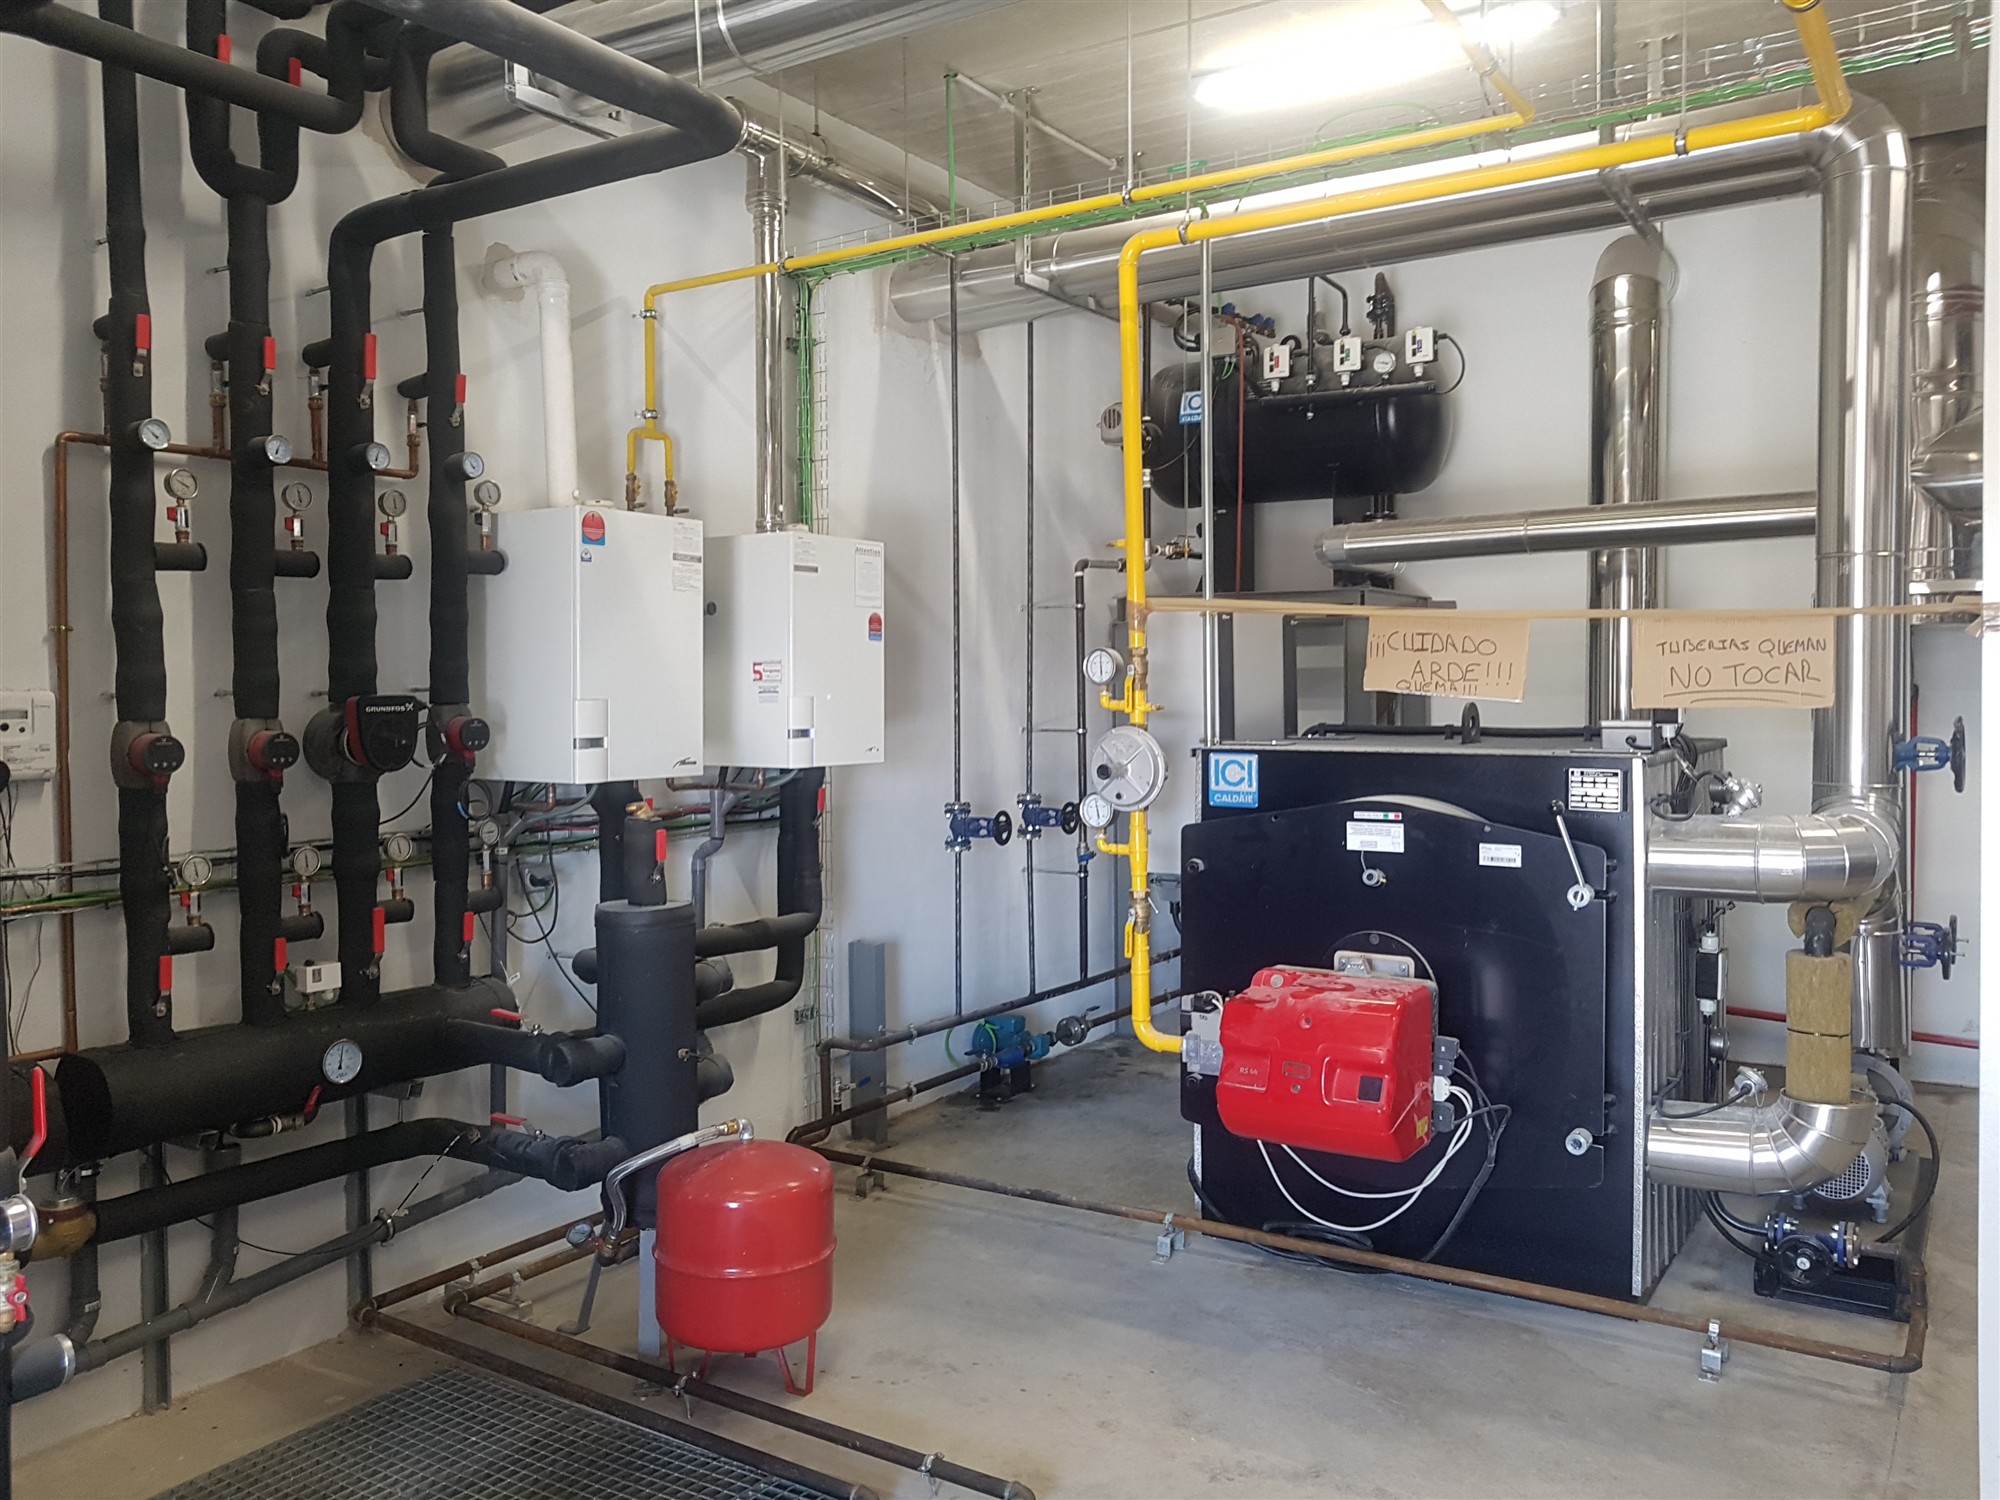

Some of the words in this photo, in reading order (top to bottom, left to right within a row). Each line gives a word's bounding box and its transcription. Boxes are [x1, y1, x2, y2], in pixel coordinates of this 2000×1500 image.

[1656, 638, 1750, 656] TUBERIAS
[1758, 637, 1827, 658] QUEMAN
[1411, 660, 1513, 686] ARDE!!!
[1670, 663, 1712, 689] NO
[1722, 658, 1821, 687] TOCAR
[365, 705, 406, 713] GRUNDFOS
[1214, 759, 1253, 787] ICI
[1239, 1066, 1249, 1075] RS
